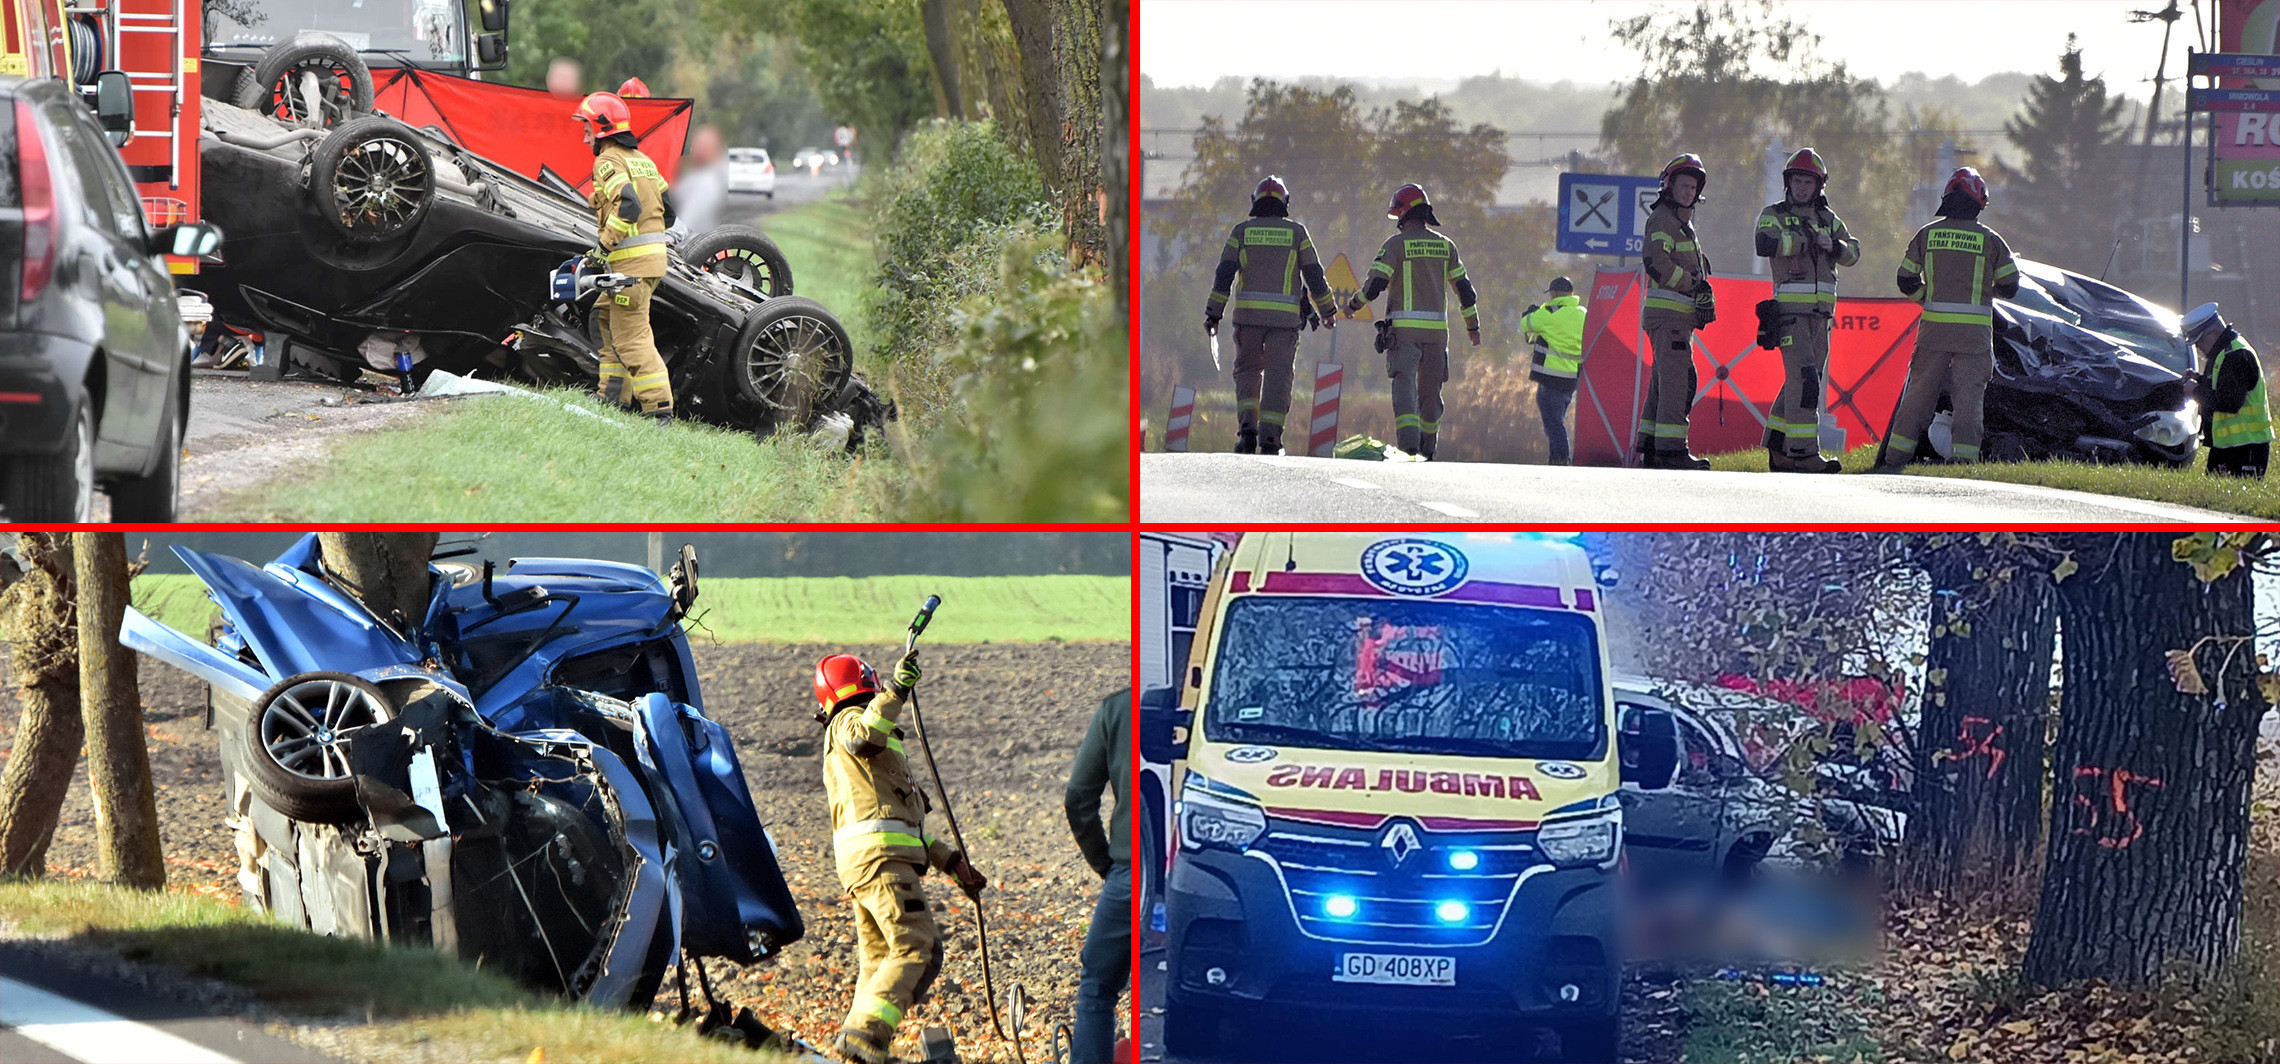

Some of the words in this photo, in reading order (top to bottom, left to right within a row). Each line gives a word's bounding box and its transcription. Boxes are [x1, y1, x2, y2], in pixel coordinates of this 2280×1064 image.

[599, 163, 611, 175] PSP
[1933, 230, 1978, 242] PAŃSTWOWA
[1348, 955, 1376, 976] GD
[1384, 957, 1451, 978] 408XP
